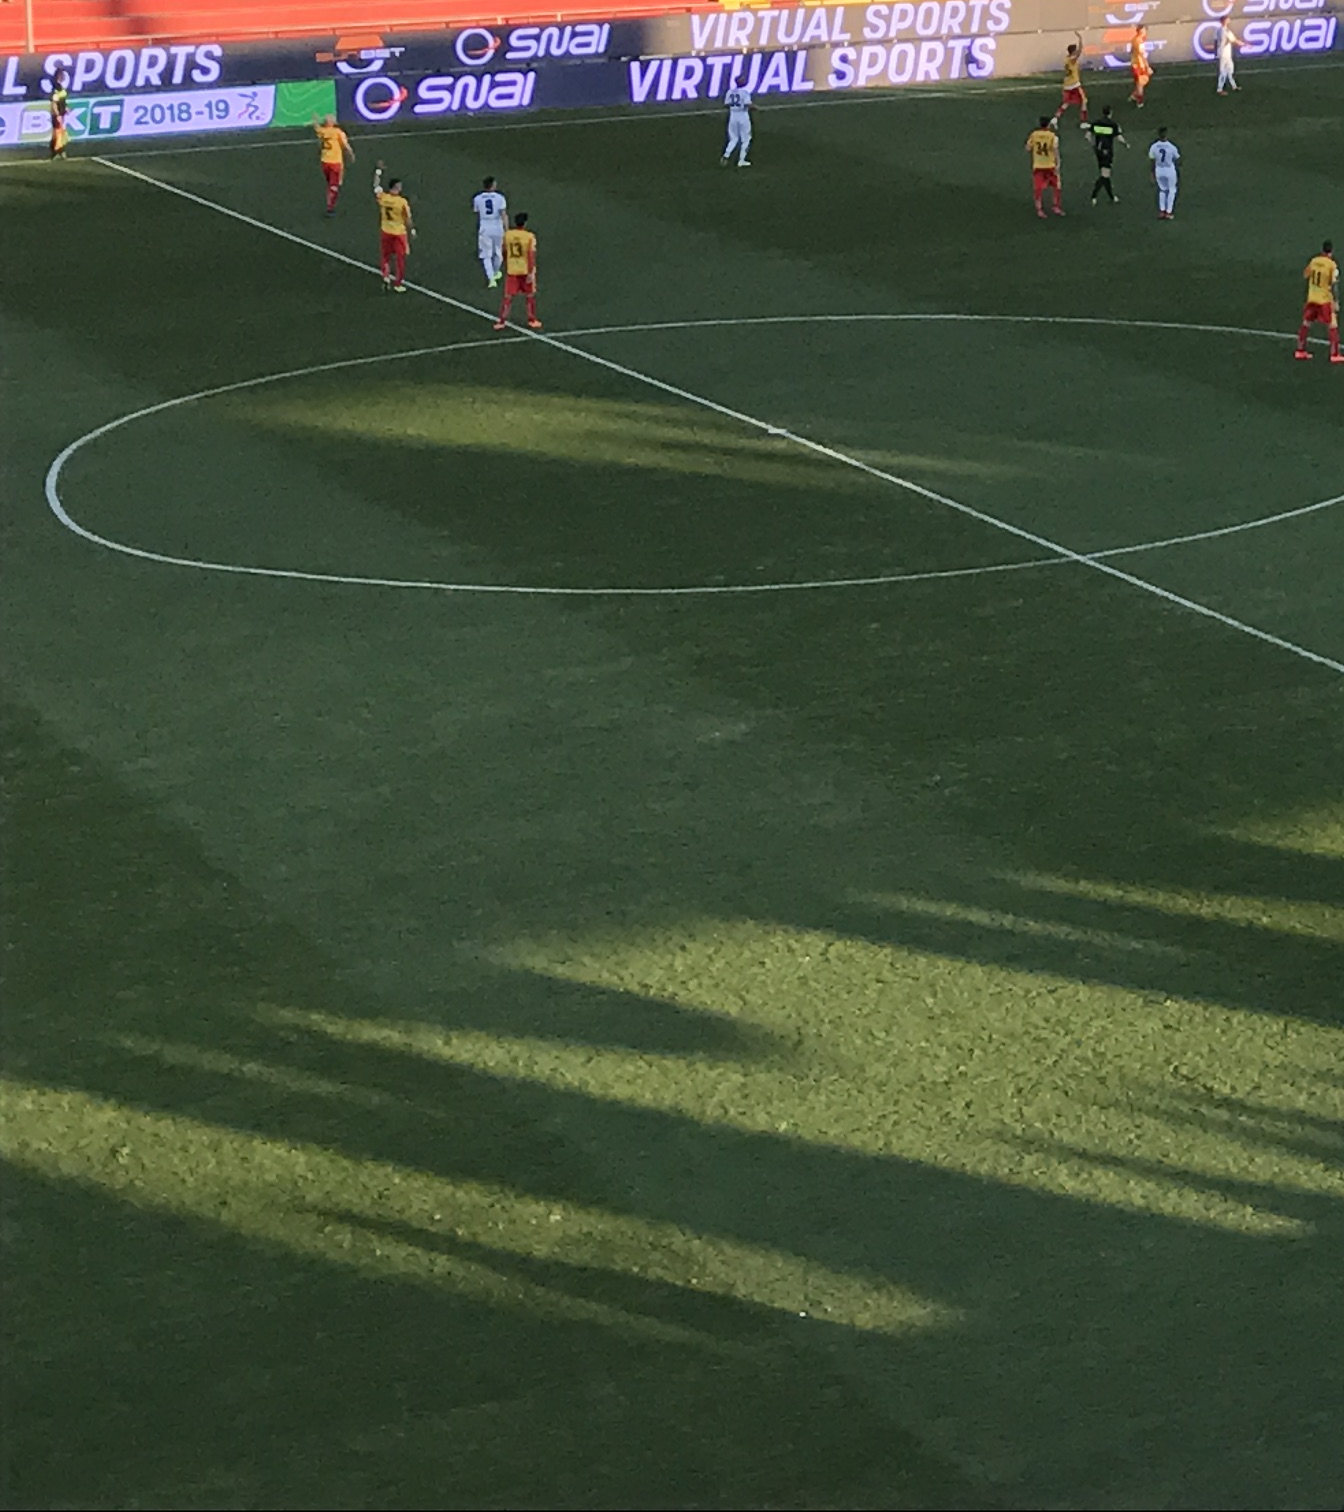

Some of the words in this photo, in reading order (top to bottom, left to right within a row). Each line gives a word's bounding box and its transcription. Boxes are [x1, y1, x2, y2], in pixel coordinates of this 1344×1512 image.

[690, 6, 852, 49] VIRTUAL
[41, 44, 223, 92] SPORTS
[629, 49, 815, 103] VIRTUAL
[828, 37, 997, 89] SPORTS
[134, 99, 230, 126] 2018-19
